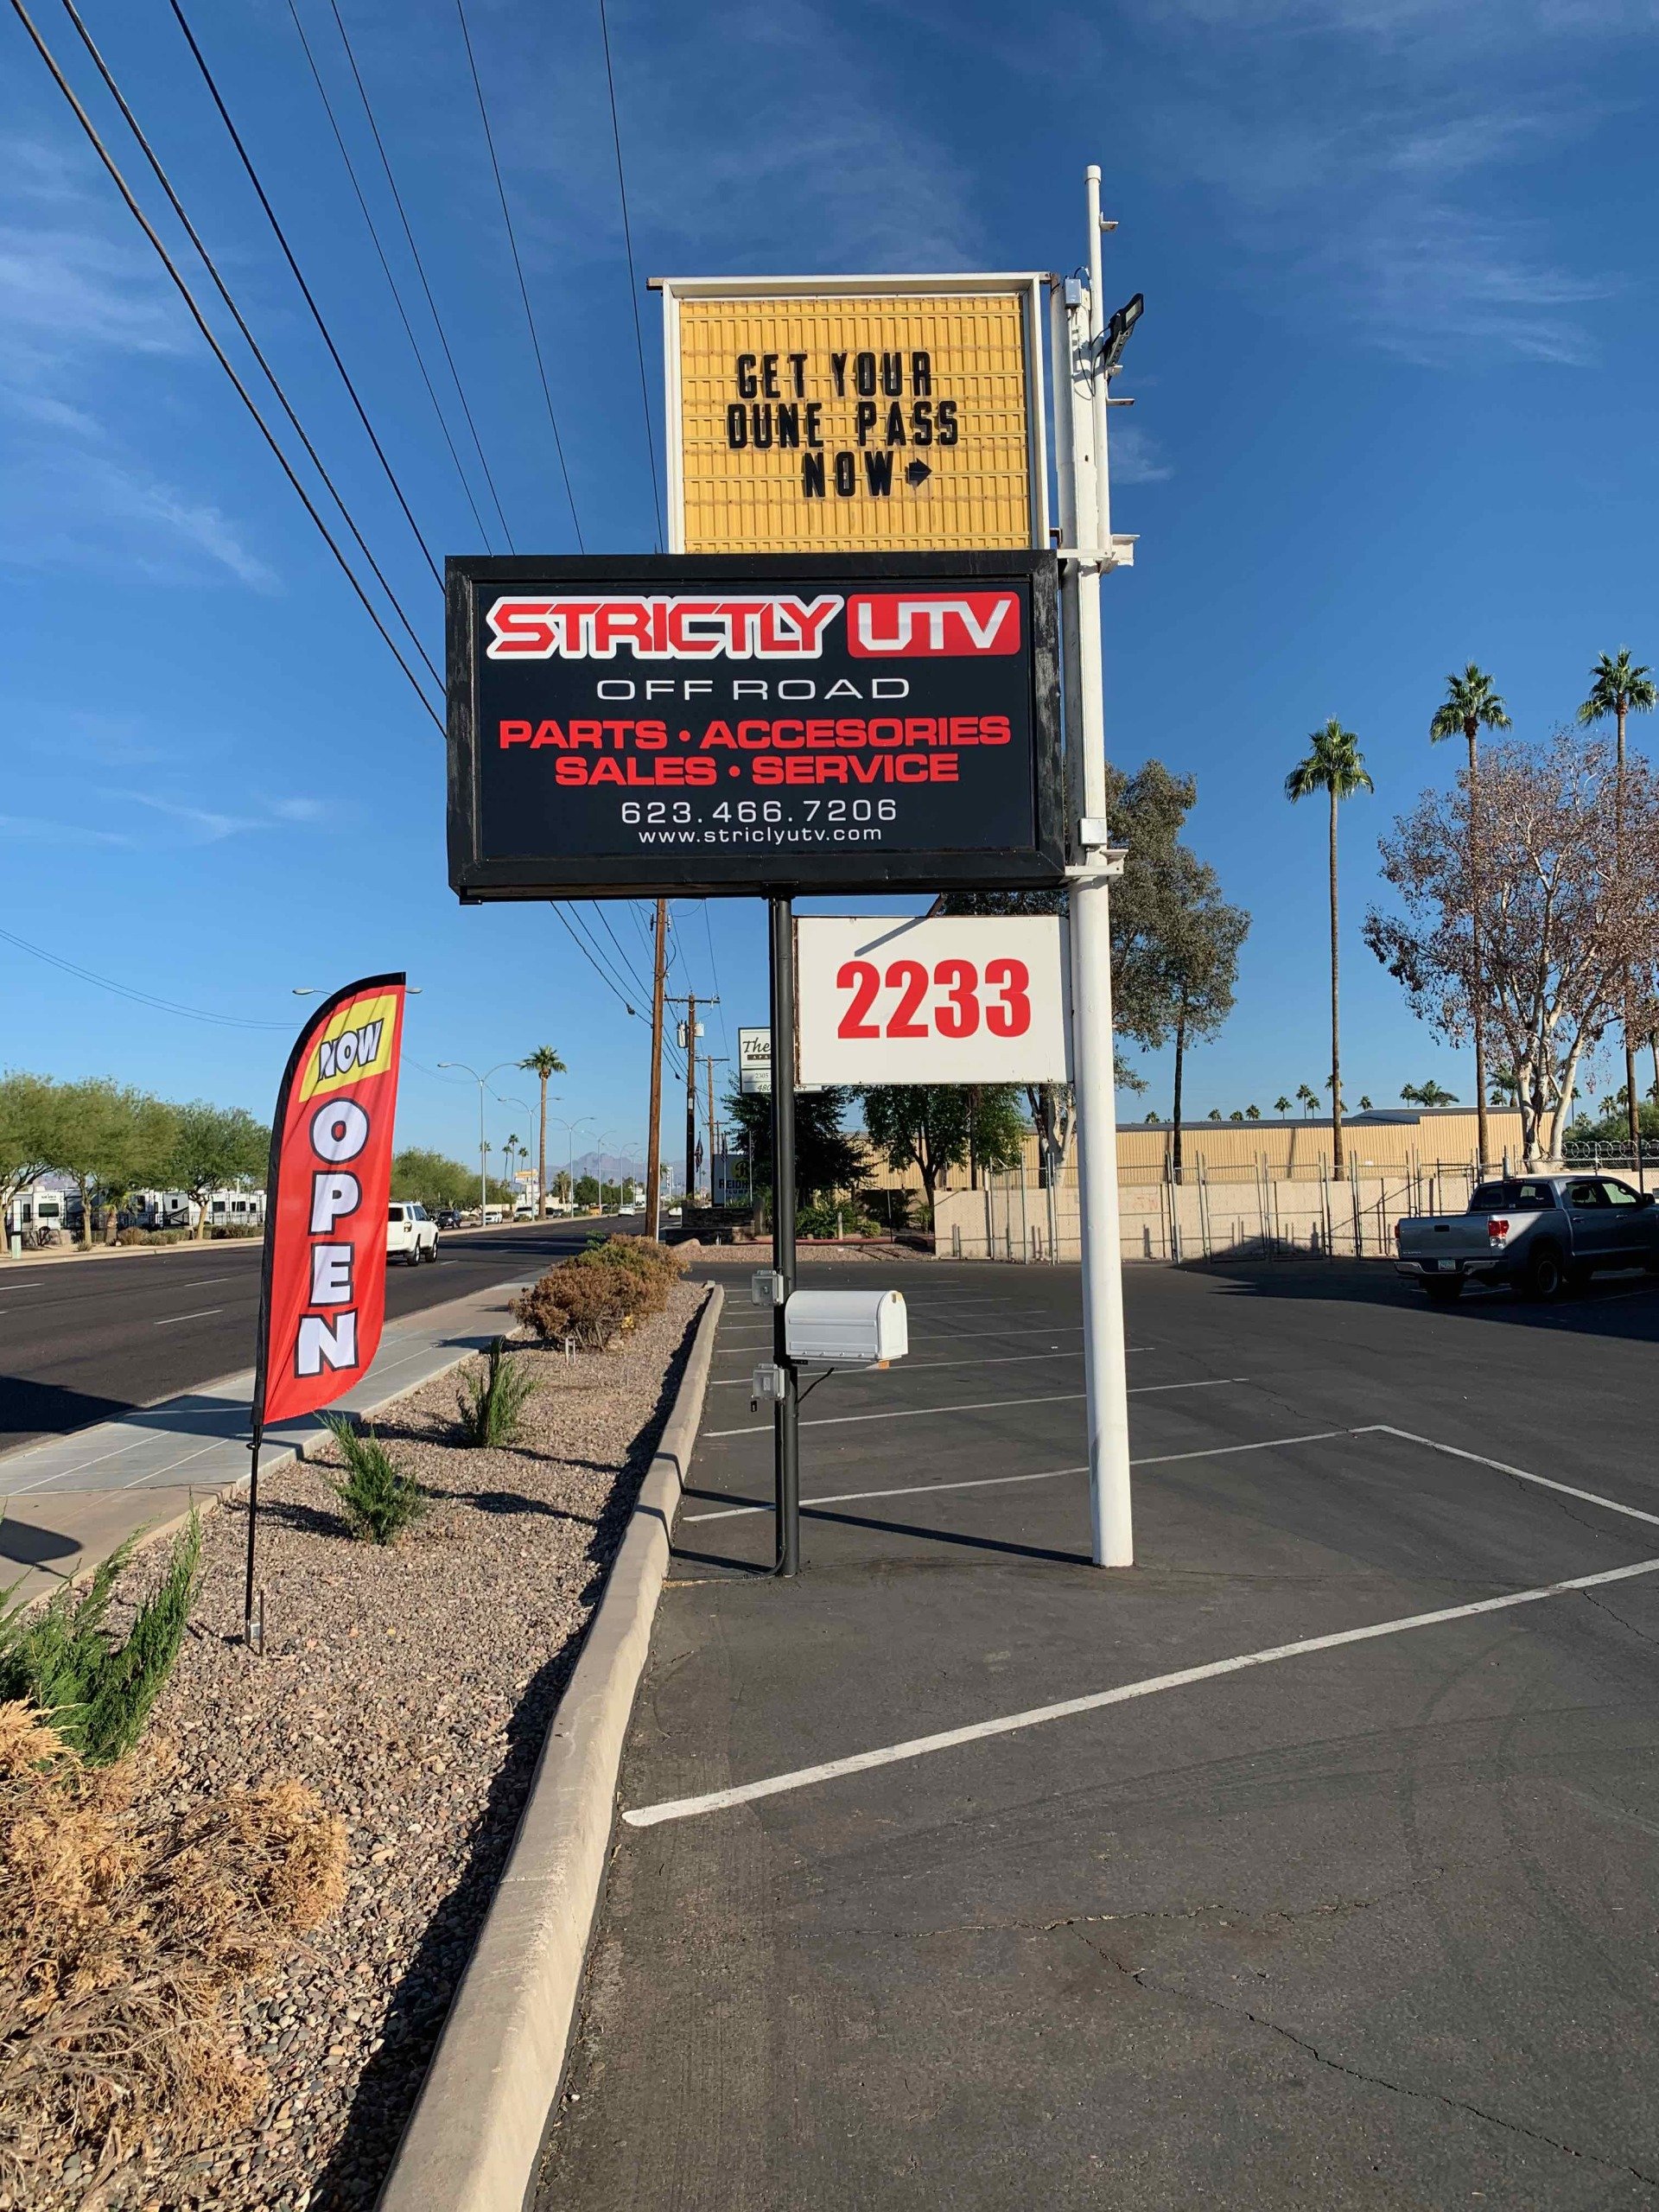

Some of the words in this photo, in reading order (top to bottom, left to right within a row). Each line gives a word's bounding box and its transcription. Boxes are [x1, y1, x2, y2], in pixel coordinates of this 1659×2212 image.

[737, 353, 808, 399] GET
[831, 351, 931, 397] YOUR
[728, 402, 824, 449] DUNE
[855, 400, 958, 447] PASS
[804, 450, 894, 498] NOW
[486, 595, 844, 659] STRICTLY
[858, 600, 1009, 652] UTV
[597, 679, 714, 701] OFF
[733, 677, 910, 701] ROAD
[499, 720, 668, 749] PARTS
[701, 715, 1011, 749] ACCESORIES
[556, 756, 717, 785] SALES
[752, 753, 959, 785] SERVICE
[621, 799, 897, 824] 623.466.7206
[639, 827, 881, 845] www.striclyutv.com
[836, 958, 1031, 1039] 2233
[318, 1018, 384, 1080] NOW
[742, 1037, 771, 1053] The
[294, 1097, 370, 1378] OPEN
